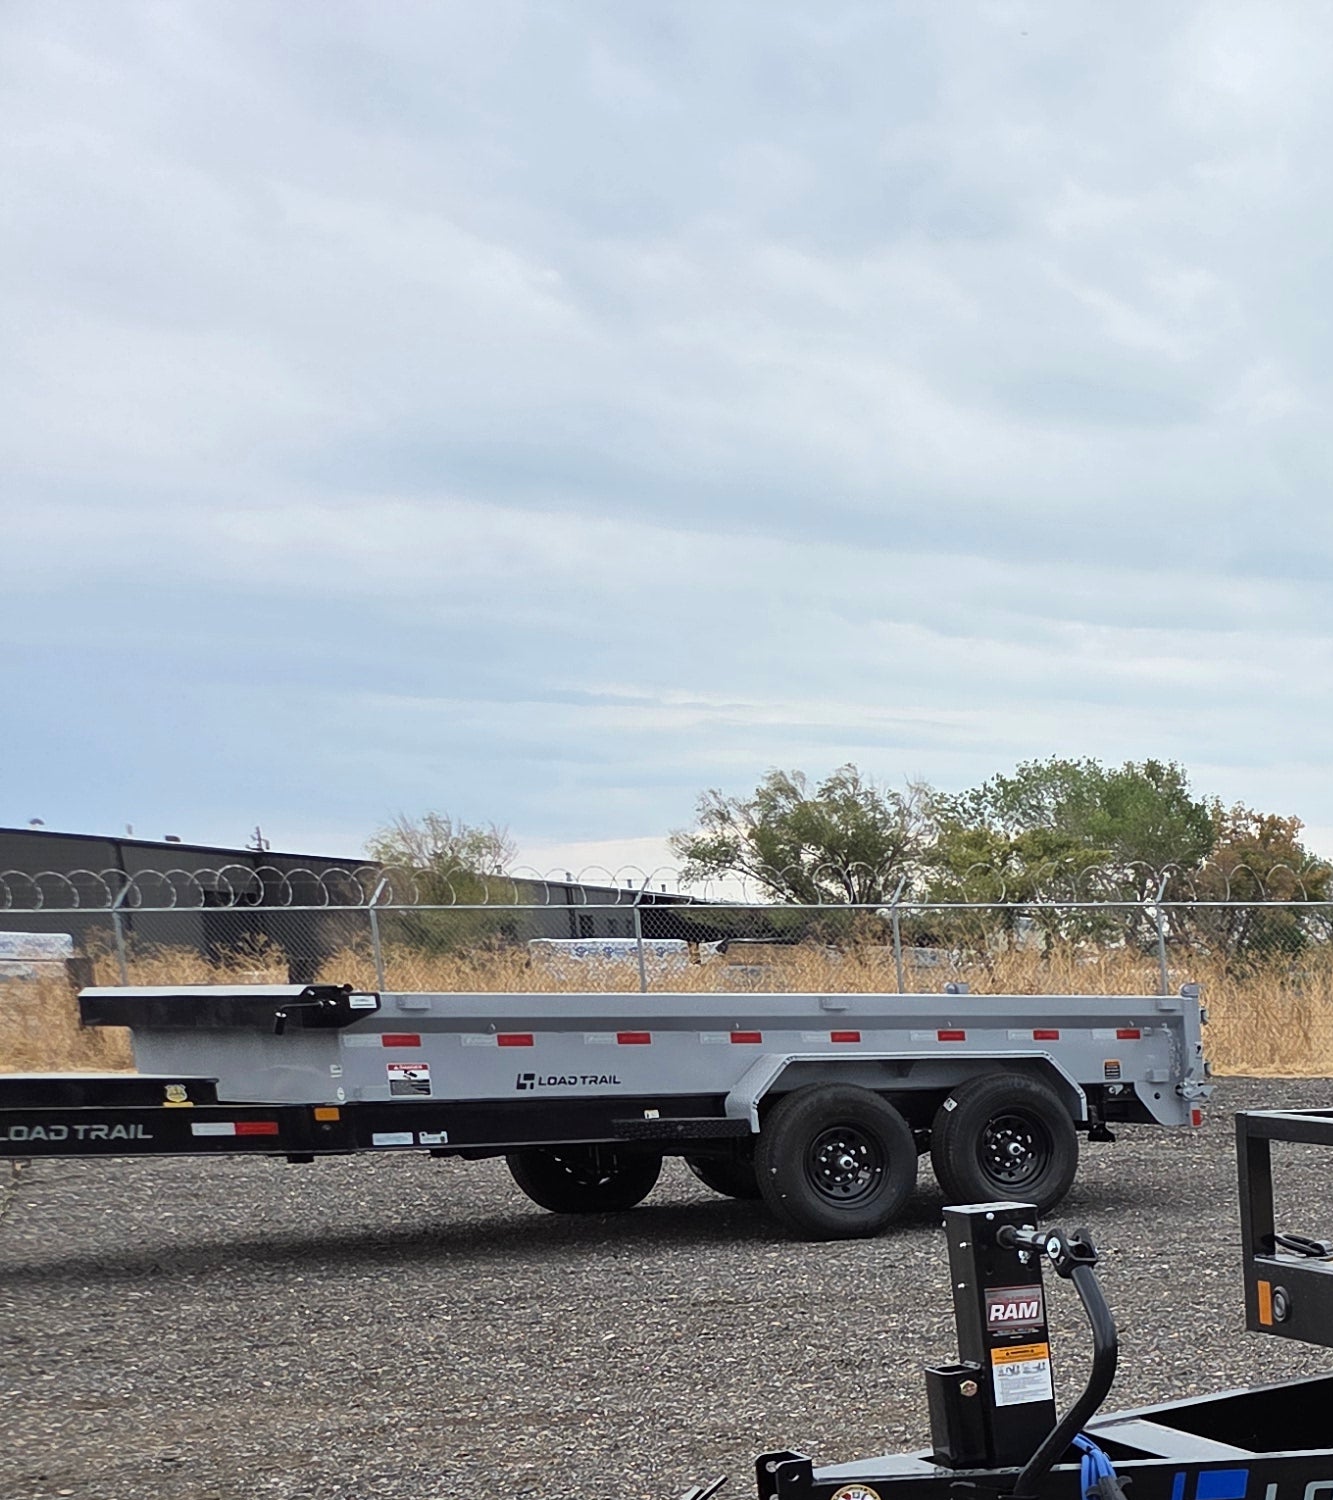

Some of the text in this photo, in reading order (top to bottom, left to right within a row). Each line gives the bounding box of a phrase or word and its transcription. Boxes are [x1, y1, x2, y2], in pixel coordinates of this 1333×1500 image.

[538, 1074, 621, 1086] LOAD TRAIL
[73, 1124, 154, 1140] TRAIL
[989, 1301, 1039, 1322] RAM
